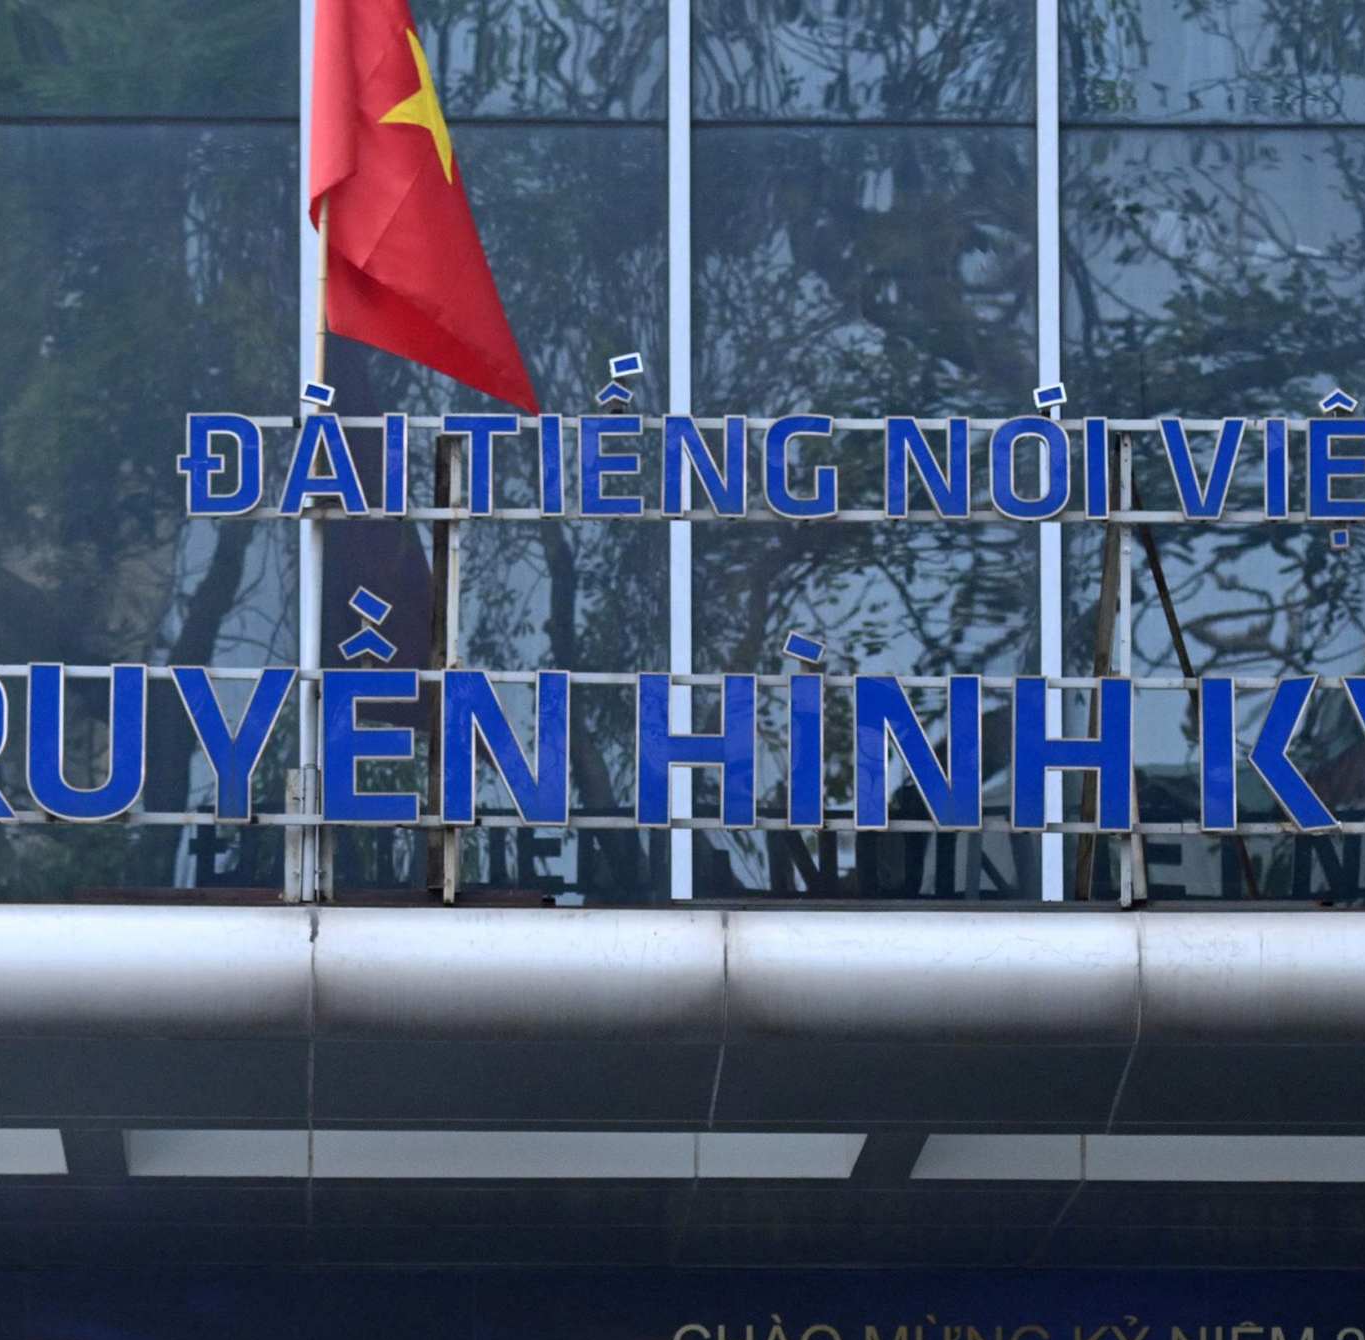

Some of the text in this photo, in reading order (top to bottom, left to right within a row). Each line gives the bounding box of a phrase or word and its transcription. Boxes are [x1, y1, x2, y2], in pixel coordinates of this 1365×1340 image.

[177, 378, 409, 519] ĐÀI
[442, 352, 838, 521] TIẾNG
[884, 380, 1110, 521] NÓI
[635, 631, 1134, 832] HÌNH
